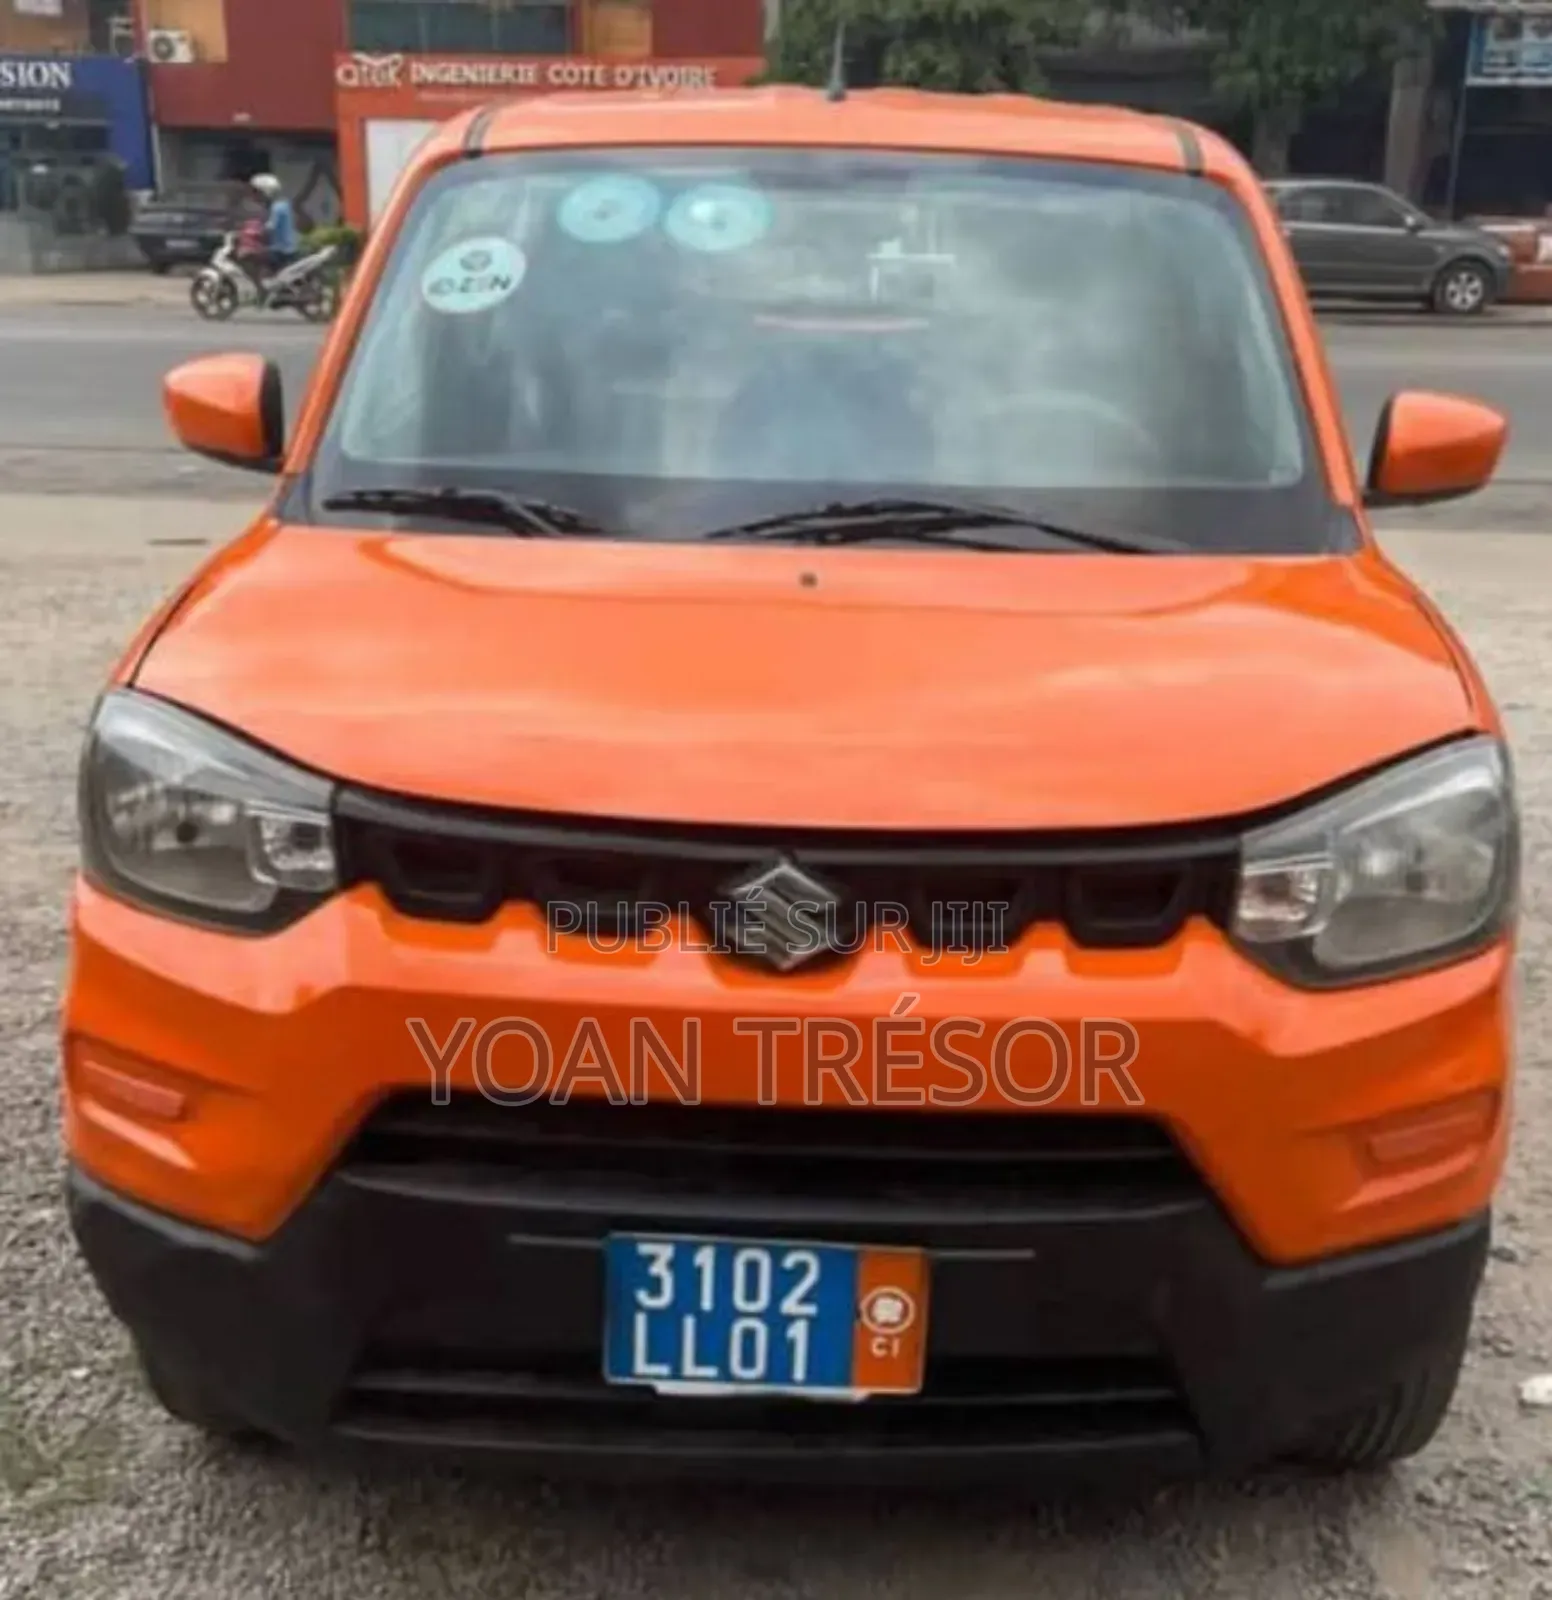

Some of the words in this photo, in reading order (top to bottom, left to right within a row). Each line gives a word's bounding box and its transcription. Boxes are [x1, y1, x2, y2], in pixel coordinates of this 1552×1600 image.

[0, 61, 72, 89] SION
[634, 1242, 821, 1316] 3102
[632, 1311, 809, 1384] LL01
[871, 1336, 900, 1359] CI
